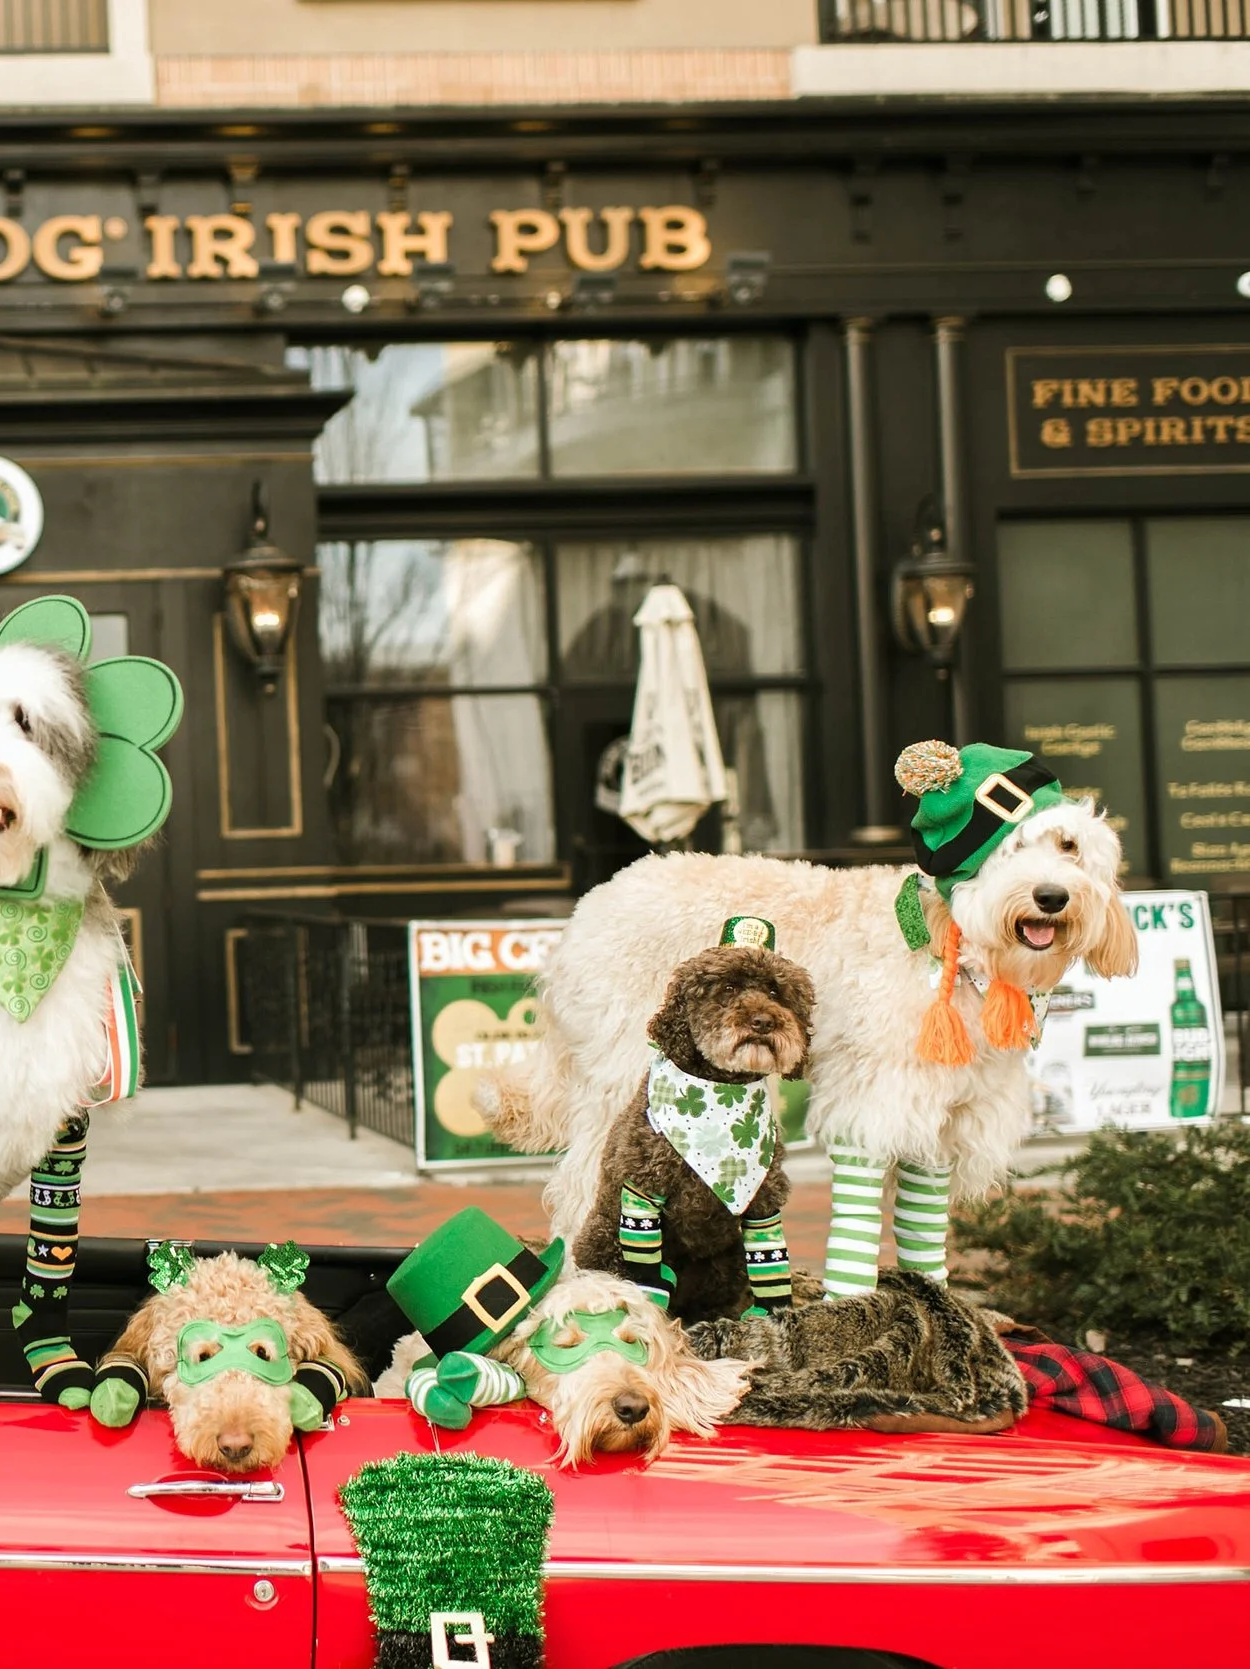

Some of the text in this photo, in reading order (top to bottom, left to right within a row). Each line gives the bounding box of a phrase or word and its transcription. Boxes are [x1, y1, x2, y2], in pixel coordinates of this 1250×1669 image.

[145, 210, 452, 279] IRISH
[490, 205, 712, 273] PUB
[1032, 375, 1250, 408] FINE FOO
[1040, 417, 1071, 448] &
[1131, 902, 1195, 931] CK'S
[419, 932, 494, 970] BIG
